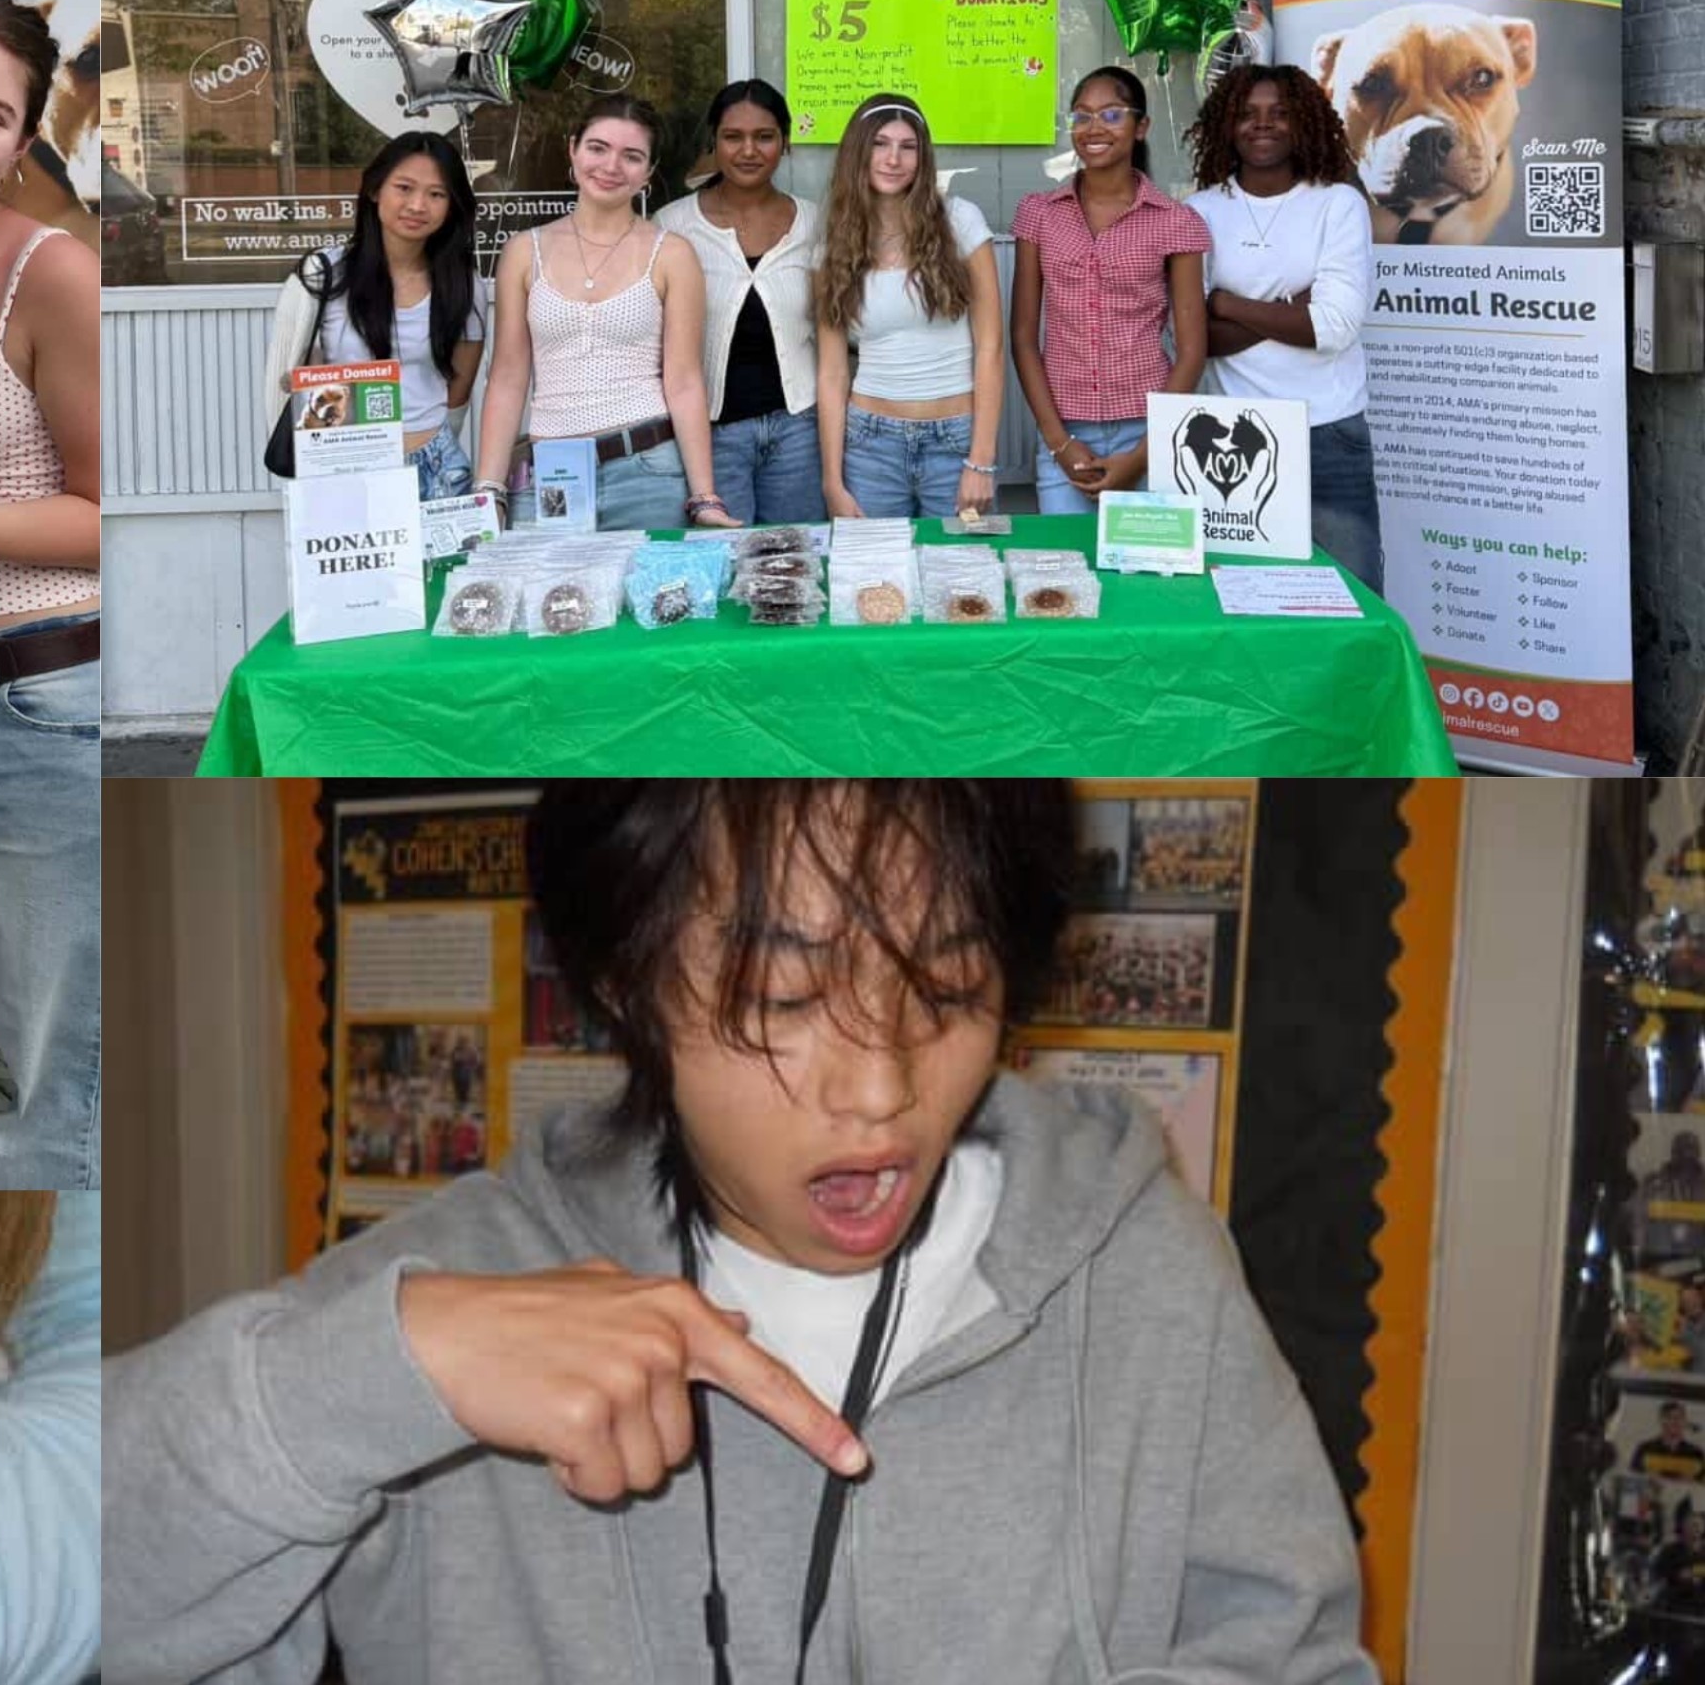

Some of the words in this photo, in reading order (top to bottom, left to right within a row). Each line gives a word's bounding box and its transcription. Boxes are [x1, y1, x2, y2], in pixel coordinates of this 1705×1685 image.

[809, 0, 872, 43] $5
[320, 34, 352, 48] Open
[1522, 137, 1570, 160] Scan
[1571, 137, 1608, 156] Me
[194, 202, 228, 223] No
[232, 200, 333, 223] walk-ins.
[1376, 261, 1400, 282] for
[1403, 261, 1492, 280] Mistreated
[1496, 264, 1567, 283] Animals
[1373, 287, 1481, 318] Animal
[1489, 291, 1597, 323] Rescue
[1563, 352, 1599, 364] based
[299, 367, 340, 383] Please
[342, 365, 392, 381] Donate!
[1529, 365, 1585, 380] dedicated
[1203, 452, 1251, 484] AMA
[1202, 507, 1254, 526] Animal
[305, 527, 409, 556] DONATE
[1202, 523, 1256, 542] Rescue
[1421, 528, 1468, 550] Ways
[1472, 536, 1504, 553] you
[1508, 542, 1538, 558] can
[1543, 543, 1588, 565] help:
[318, 551, 397, 577] HERE!
[1532, 572, 1579, 589] Sponsor
[1446, 582, 1481, 597] Foster
[1533, 595, 1569, 611] Follow
[1446, 604, 1498, 622] Volunteer
[1533, 618, 1556, 631] Like
[1447, 626, 1487, 643] Donate
[1533, 640, 1567, 655] Share
